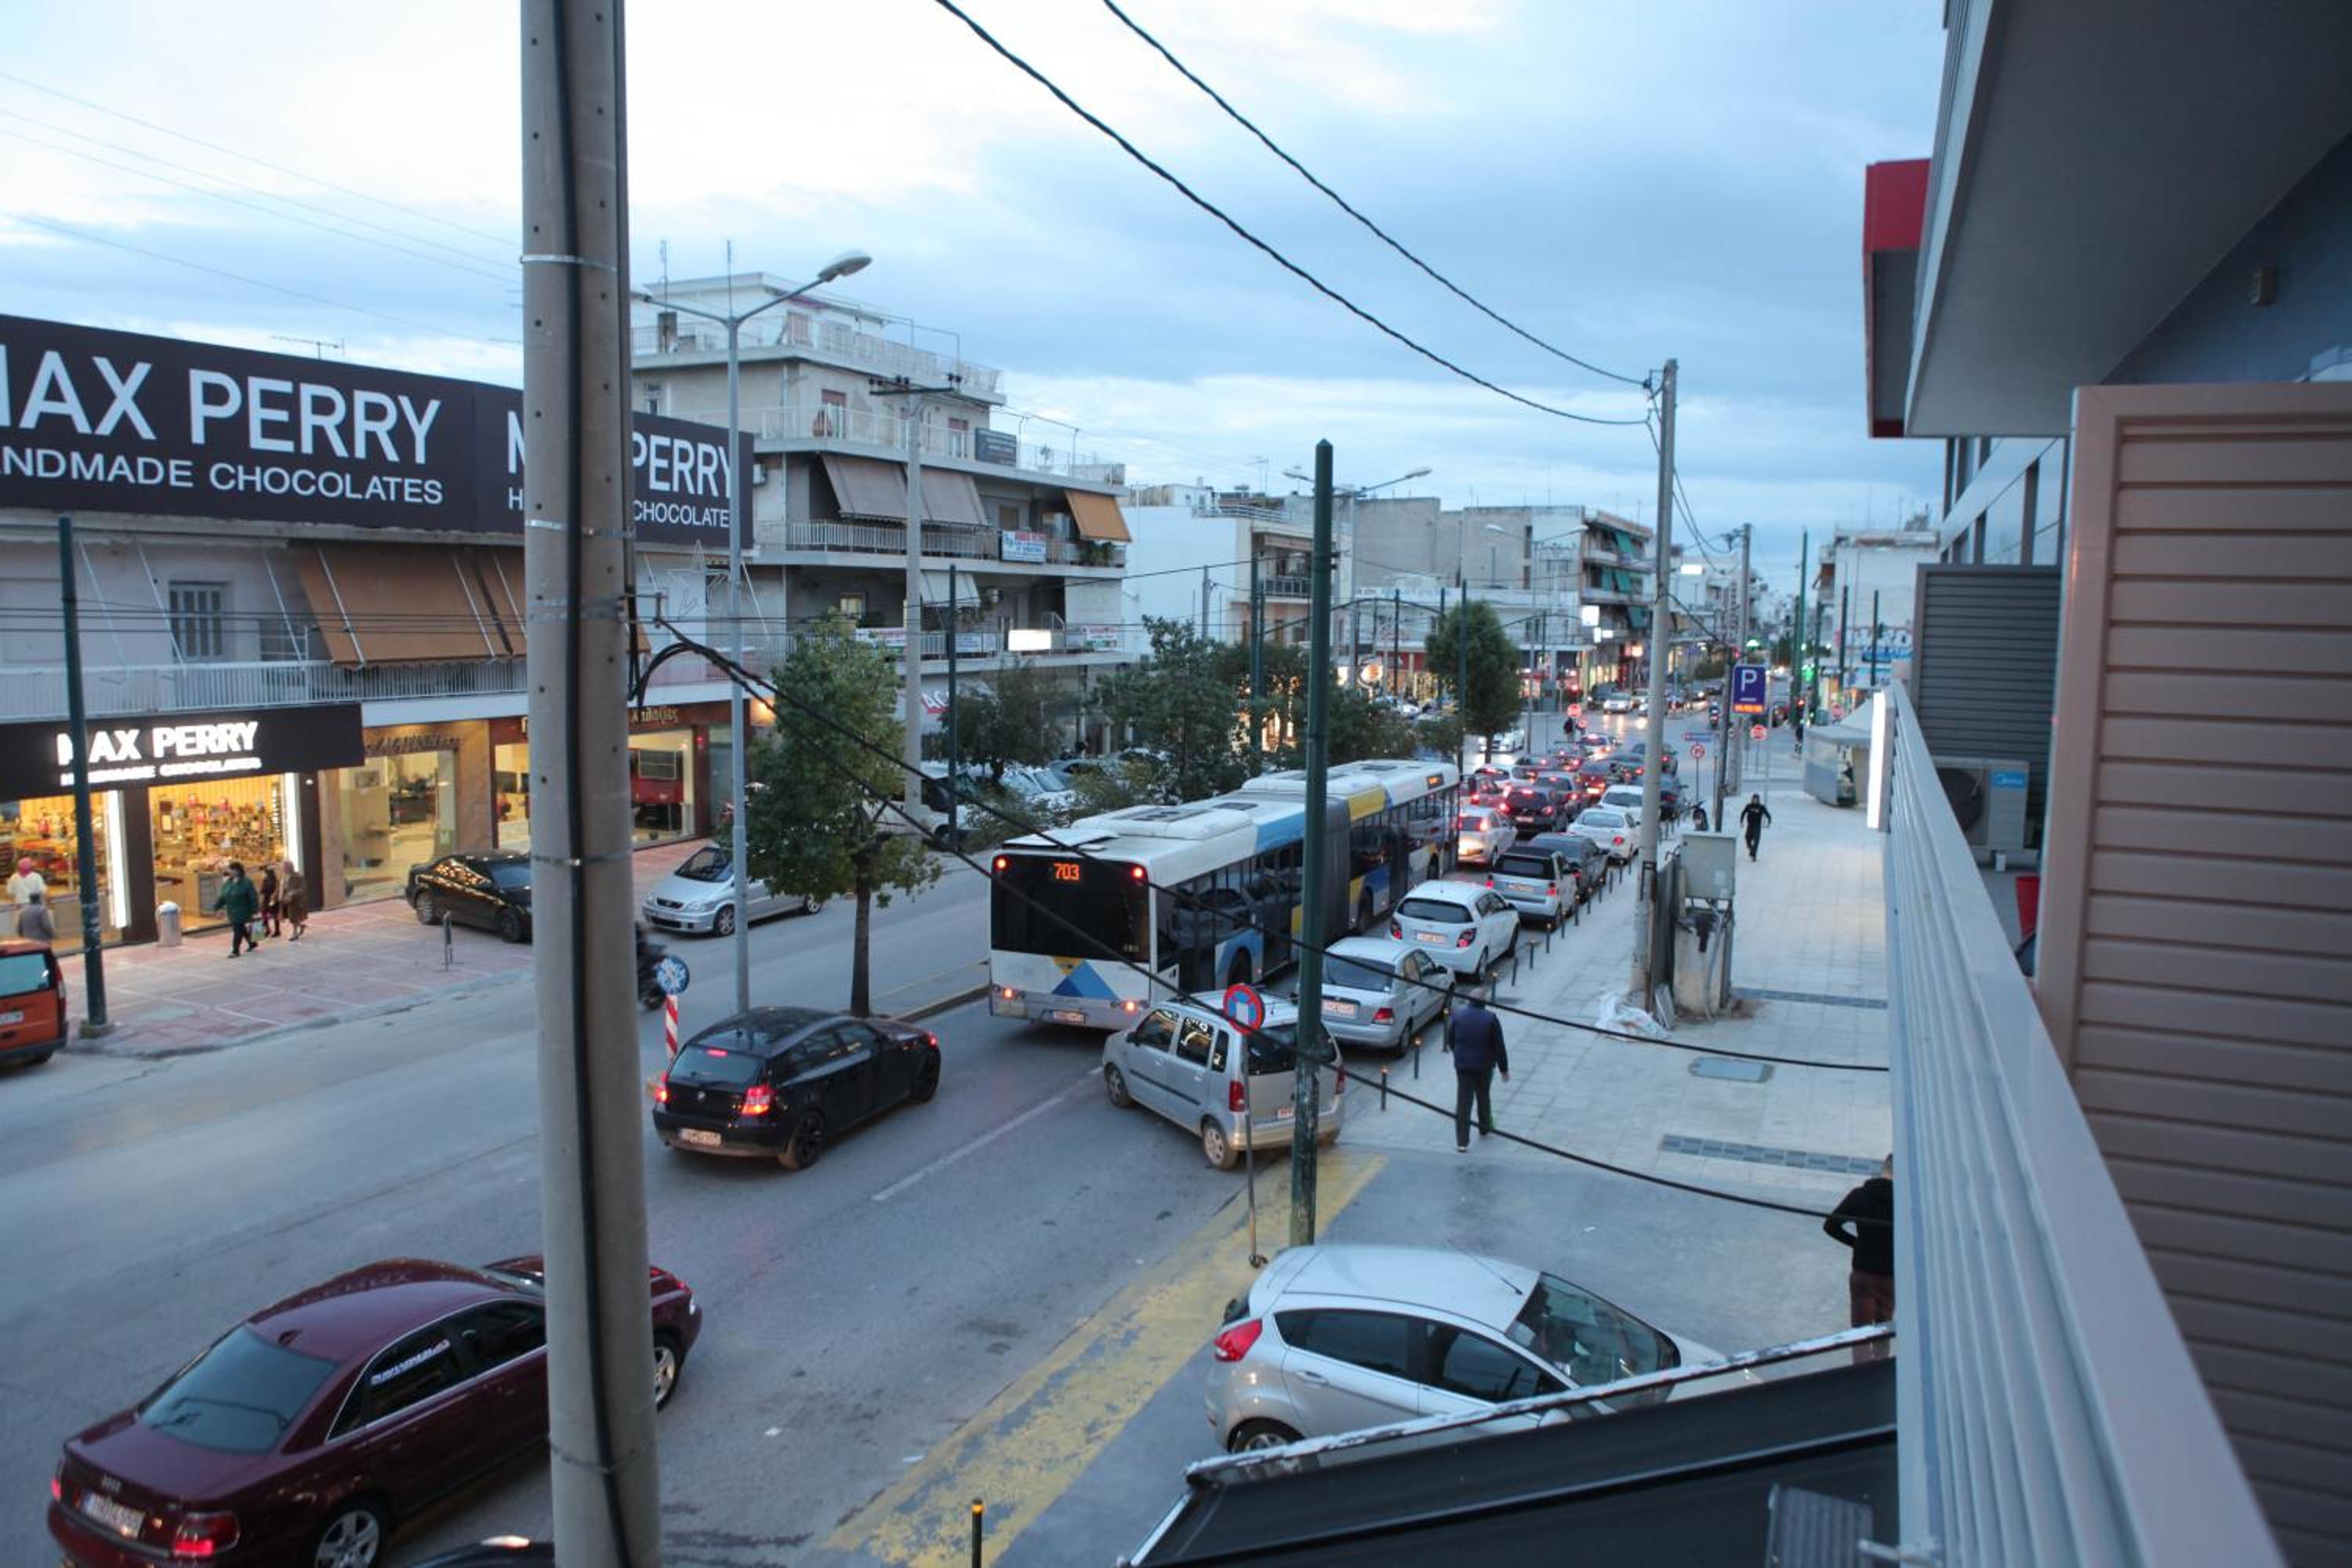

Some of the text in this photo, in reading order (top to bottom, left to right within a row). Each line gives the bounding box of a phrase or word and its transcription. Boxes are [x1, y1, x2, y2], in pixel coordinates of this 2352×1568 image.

[189, 368, 441, 464] PERRY
[0, 446, 442, 505] NDMADE CHOCOLATES
[632, 499, 730, 528] CHOCOLATE
[1741, 670, 1758, 692] P
[152, 720, 259, 758] PERRY
[1053, 862, 1080, 880] 703
